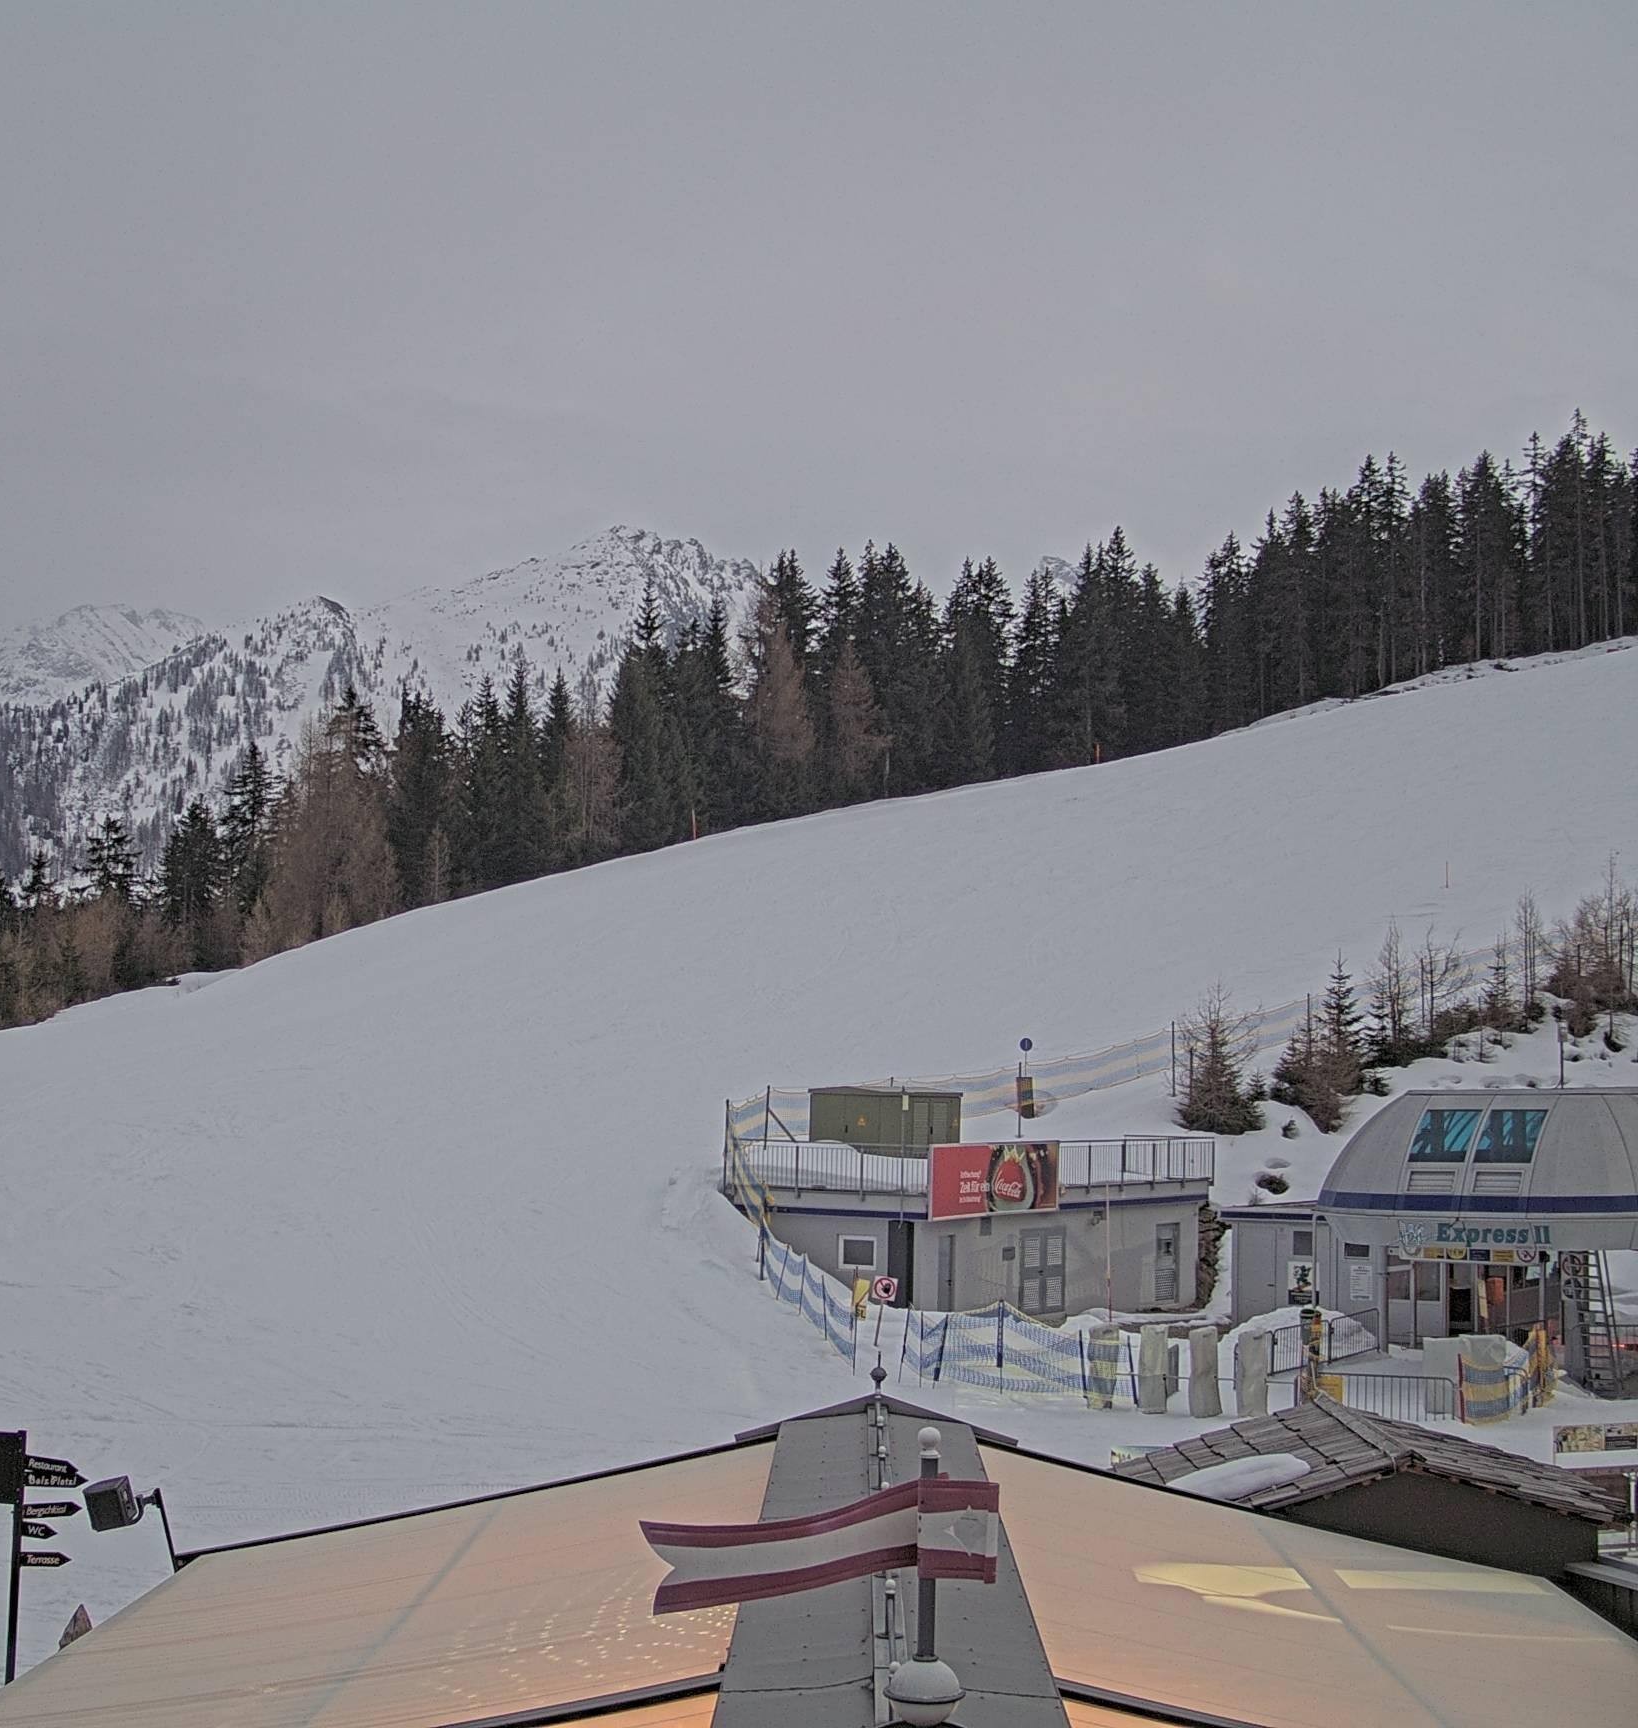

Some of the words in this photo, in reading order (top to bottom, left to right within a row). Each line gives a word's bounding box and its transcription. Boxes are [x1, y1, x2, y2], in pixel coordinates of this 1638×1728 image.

[1436, 1222, 1529, 1247] Express
[28, 1458, 68, 1473] Restaurant
[27, 1525, 46, 1536] WC
[26, 1554, 60, 1565] Terrasse
